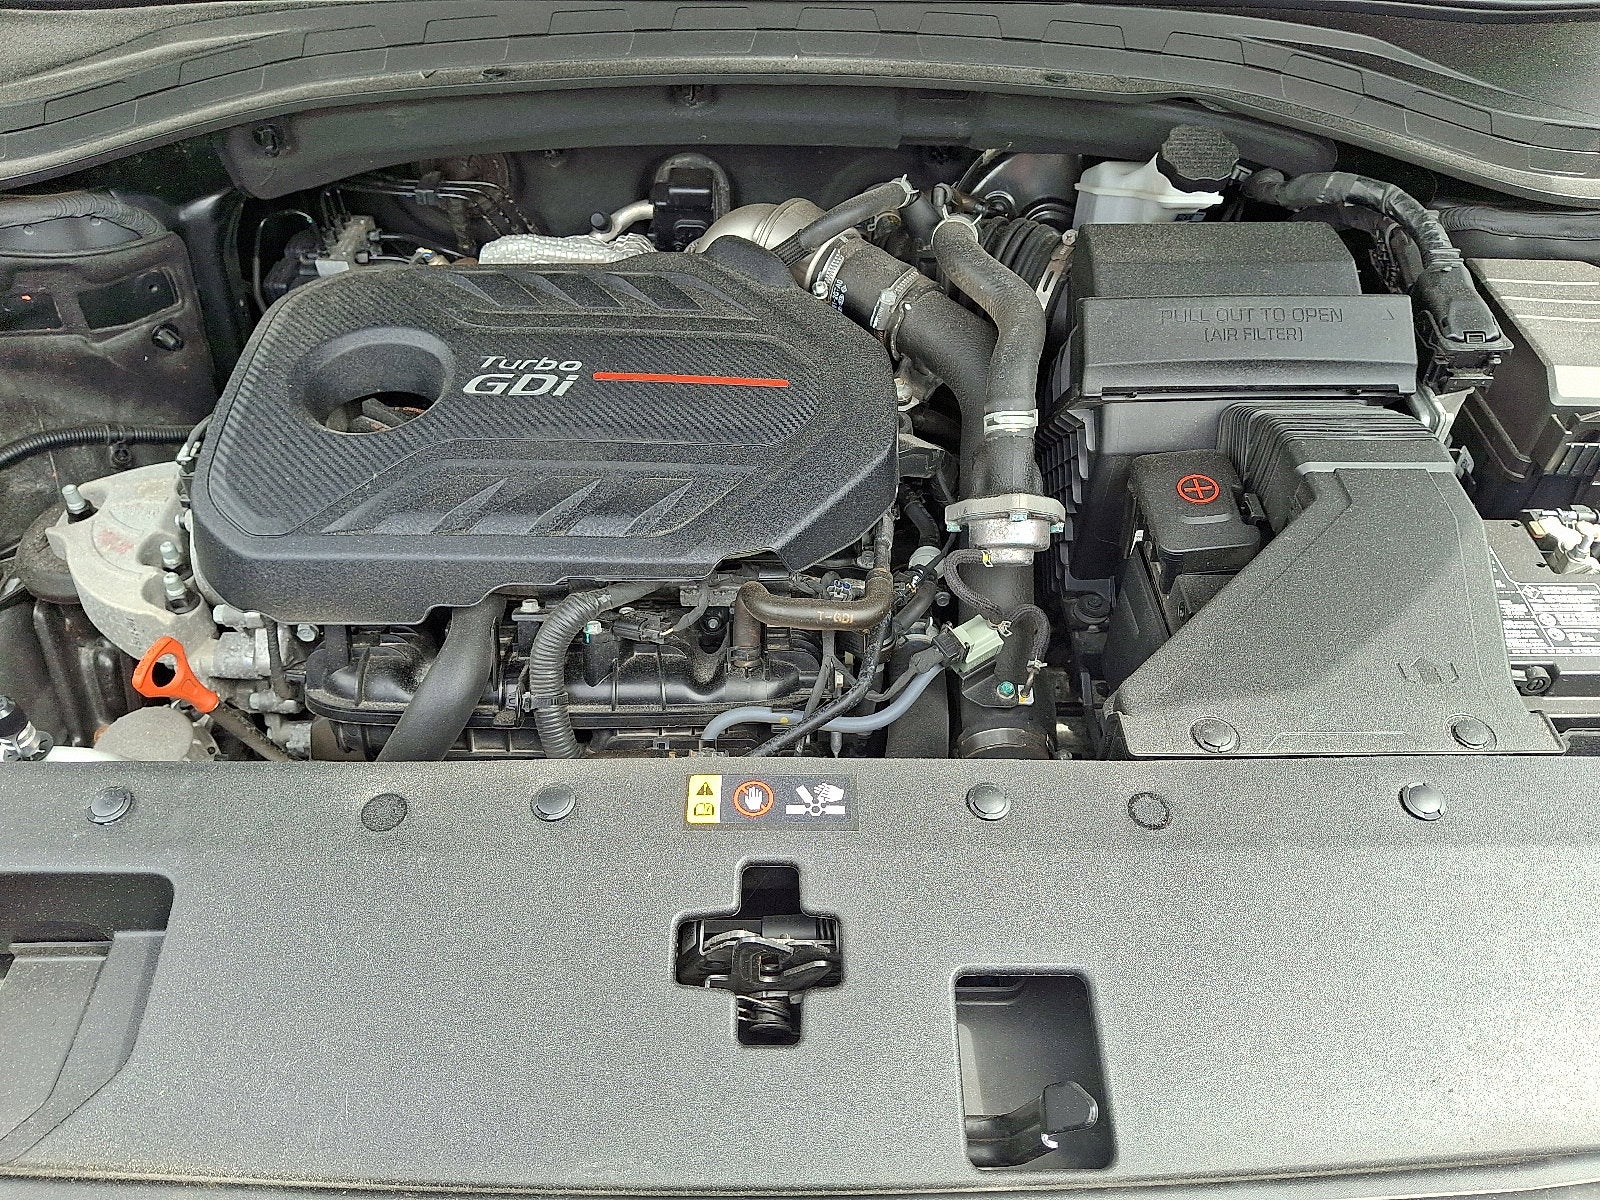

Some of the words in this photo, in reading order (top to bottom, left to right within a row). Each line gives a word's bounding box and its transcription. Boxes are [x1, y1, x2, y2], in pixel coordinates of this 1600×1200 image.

[1159, 307, 1211, 324] PULL
[1215, 307, 1254, 323] OUT
[1260, 307, 1286, 323] TO
[1292, 307, 1344, 323] OPEN
[481, 355, 583, 371] Turbo
[462, 373, 580, 397] GDi
